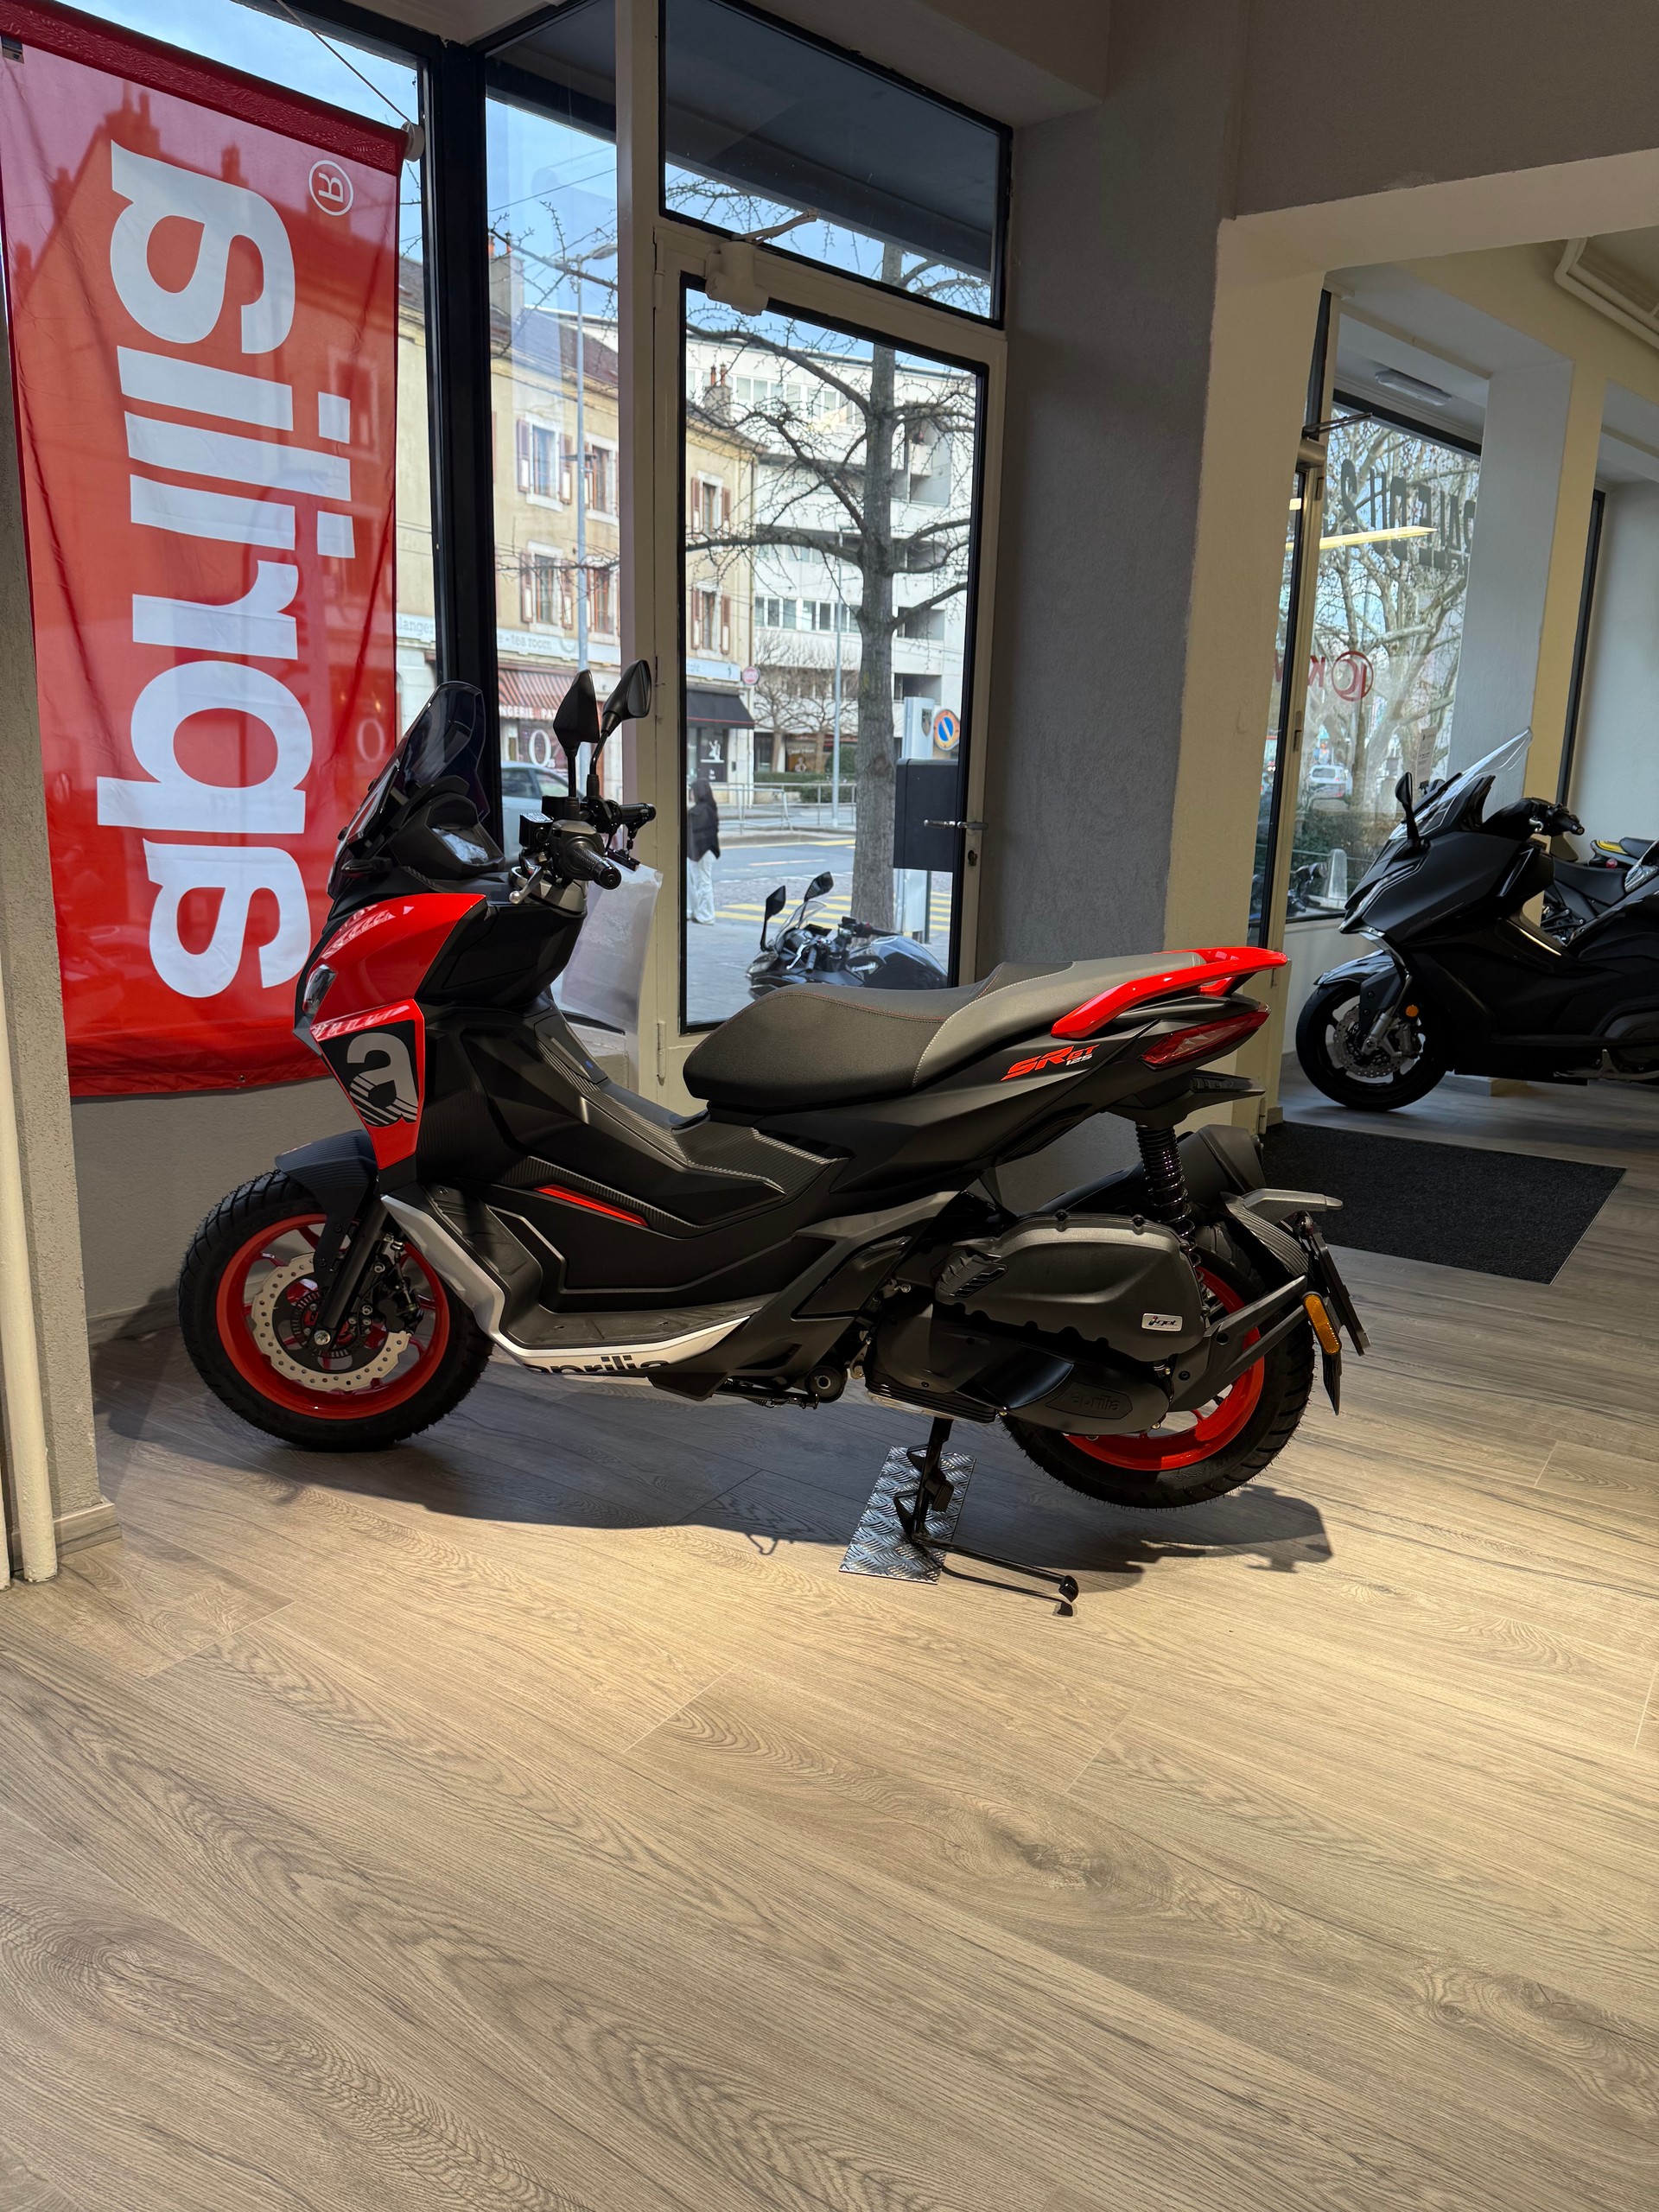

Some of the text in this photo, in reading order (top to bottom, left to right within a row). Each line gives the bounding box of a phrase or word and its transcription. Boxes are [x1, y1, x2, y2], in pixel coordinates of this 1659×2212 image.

[511, 633, 526, 646] tea
[528, 638, 552, 650] room
[1065, 1053, 1093, 1066] 125
[1070, 1392, 1121, 1411] aprilia
